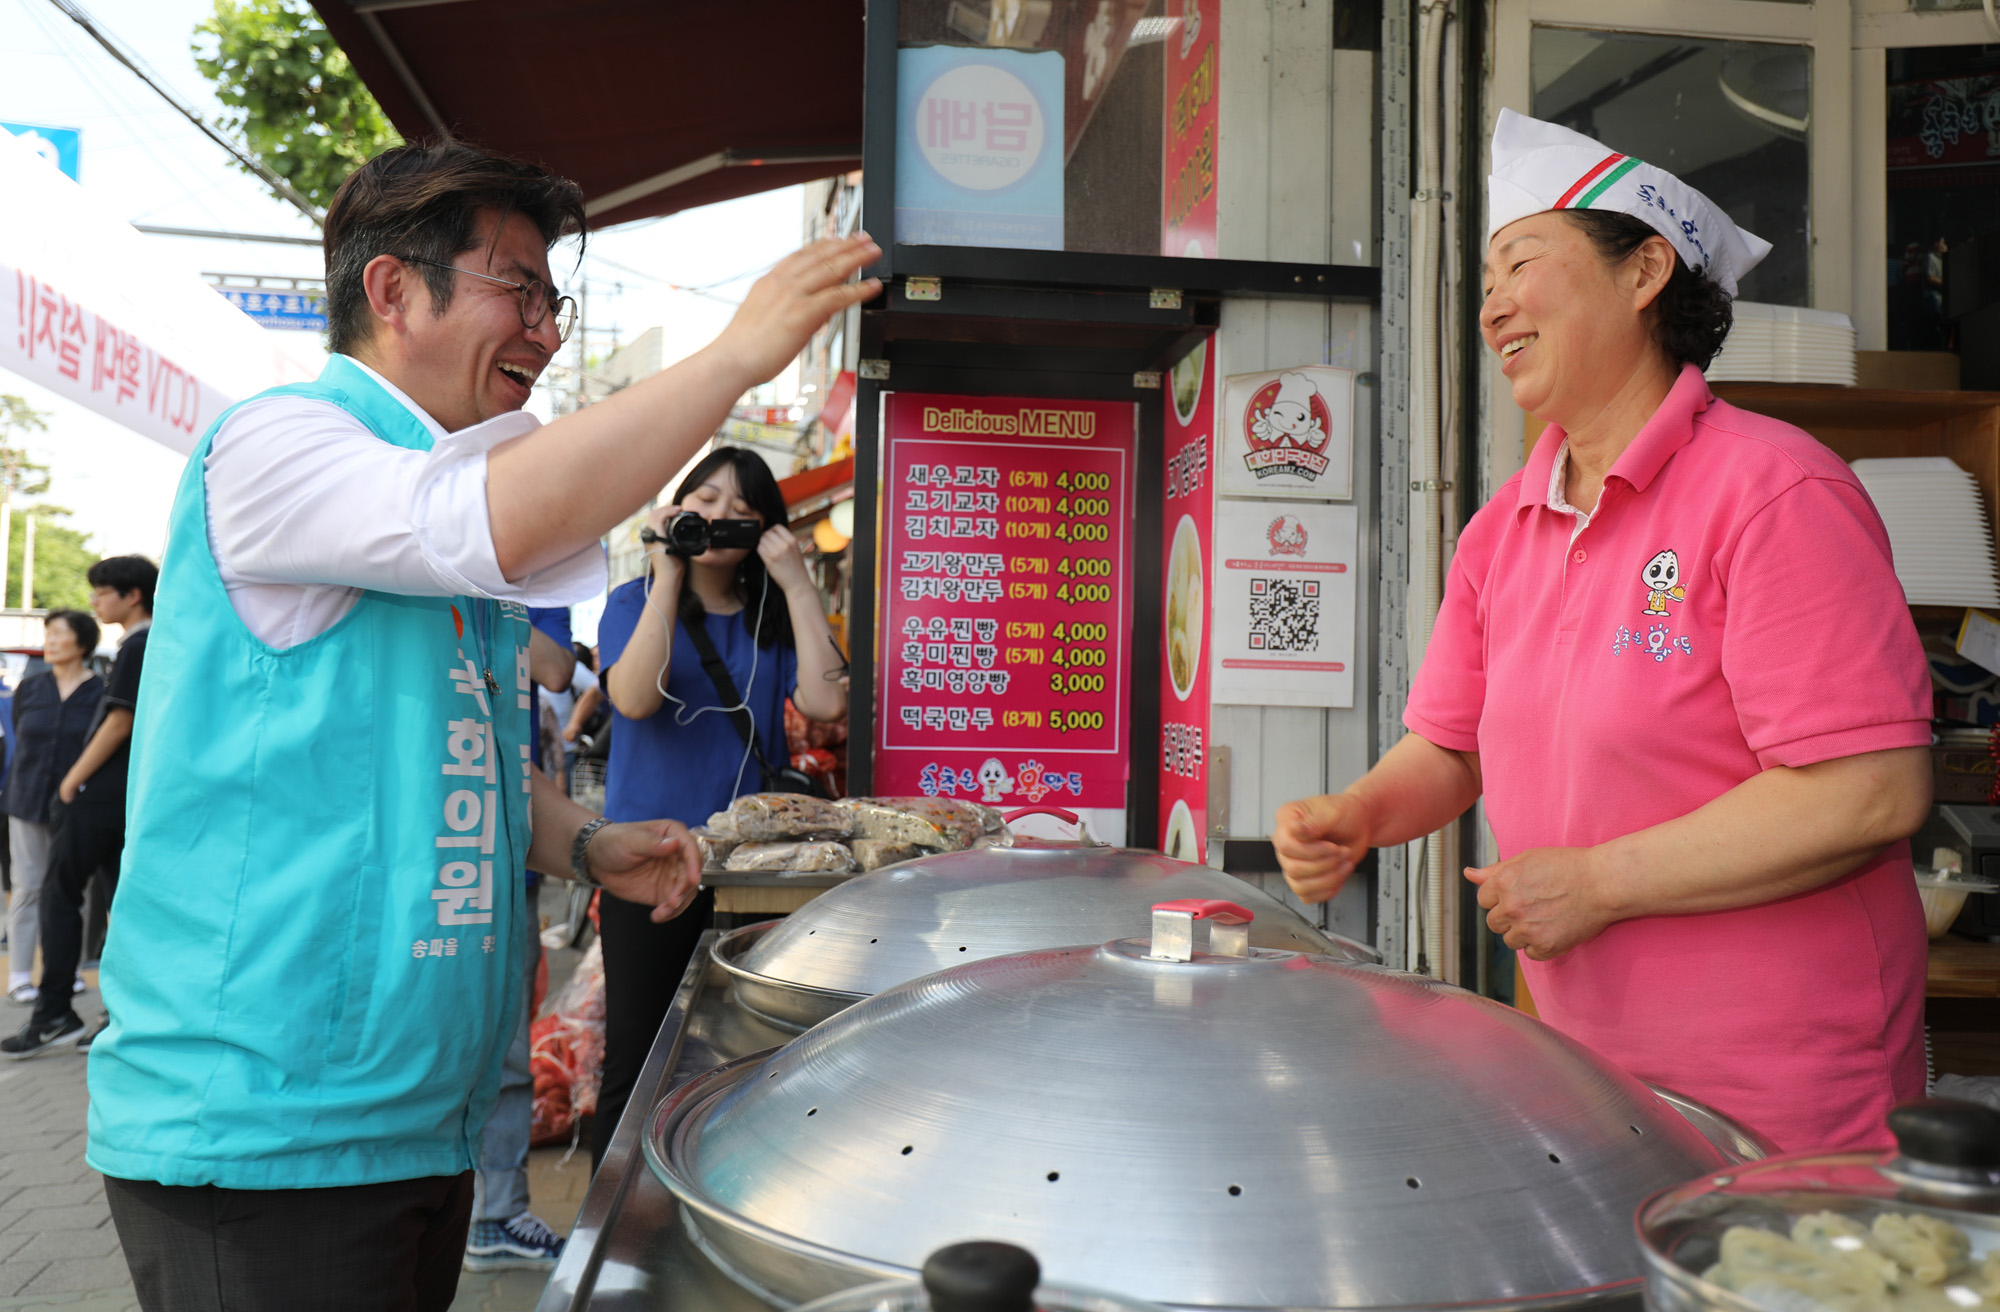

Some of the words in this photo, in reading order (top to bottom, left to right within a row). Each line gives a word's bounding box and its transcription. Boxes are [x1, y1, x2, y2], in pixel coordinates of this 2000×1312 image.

[923, 407, 1018, 435] Delicious
[1018, 409, 1096, 439] MENU
[1166, 433, 1208, 500] 고기왕만두
[1244, 447, 1329, 475] 대한민국맛집
[1256, 465, 1316, 481] KOREAMZ.COM
[906, 464, 1000, 488] 새우교자
[1009, 470, 1049, 489] (6개)
[1055, 470, 1111, 493] 4,000
[905, 491, 1000, 514] 고기교자
[1005, 496, 1051, 515] (10개)
[1055, 496, 1110, 519] 4,000
[904, 515, 1000, 540] 김치교자
[1005, 521, 1051, 540] (10개)
[1054, 522, 1109, 545] 4,000
[901, 551, 1005, 577] 고기왕만두
[1010, 556, 1050, 575] (5개)
[1056, 556, 1112, 580] 4,000
[901, 577, 1003, 602] 김치왕만두
[1008, 581, 1048, 600] (5개)
[1055, 582, 1111, 605] 4,000
[902, 616, 998, 642] 우유찐빵
[1005, 622, 1045, 640] (5개)
[1052, 621, 1108, 644] 4,000
[902, 643, 997, 668] 흑미찐빵
[1005, 648, 1045, 665] (5개)
[1051, 647, 1106, 670] 4,000
[901, 668, 1010, 694] 흑미영양빵
[1050, 673, 1105, 696] 3,000
[900, 706, 994, 731] 떡국만두
[1002, 711, 1042, 728] (8개)
[1049, 710, 1104, 733] 5,000
[1015, 759, 1083, 803] 왕만두
[411, 937, 458, 959] 송파을
